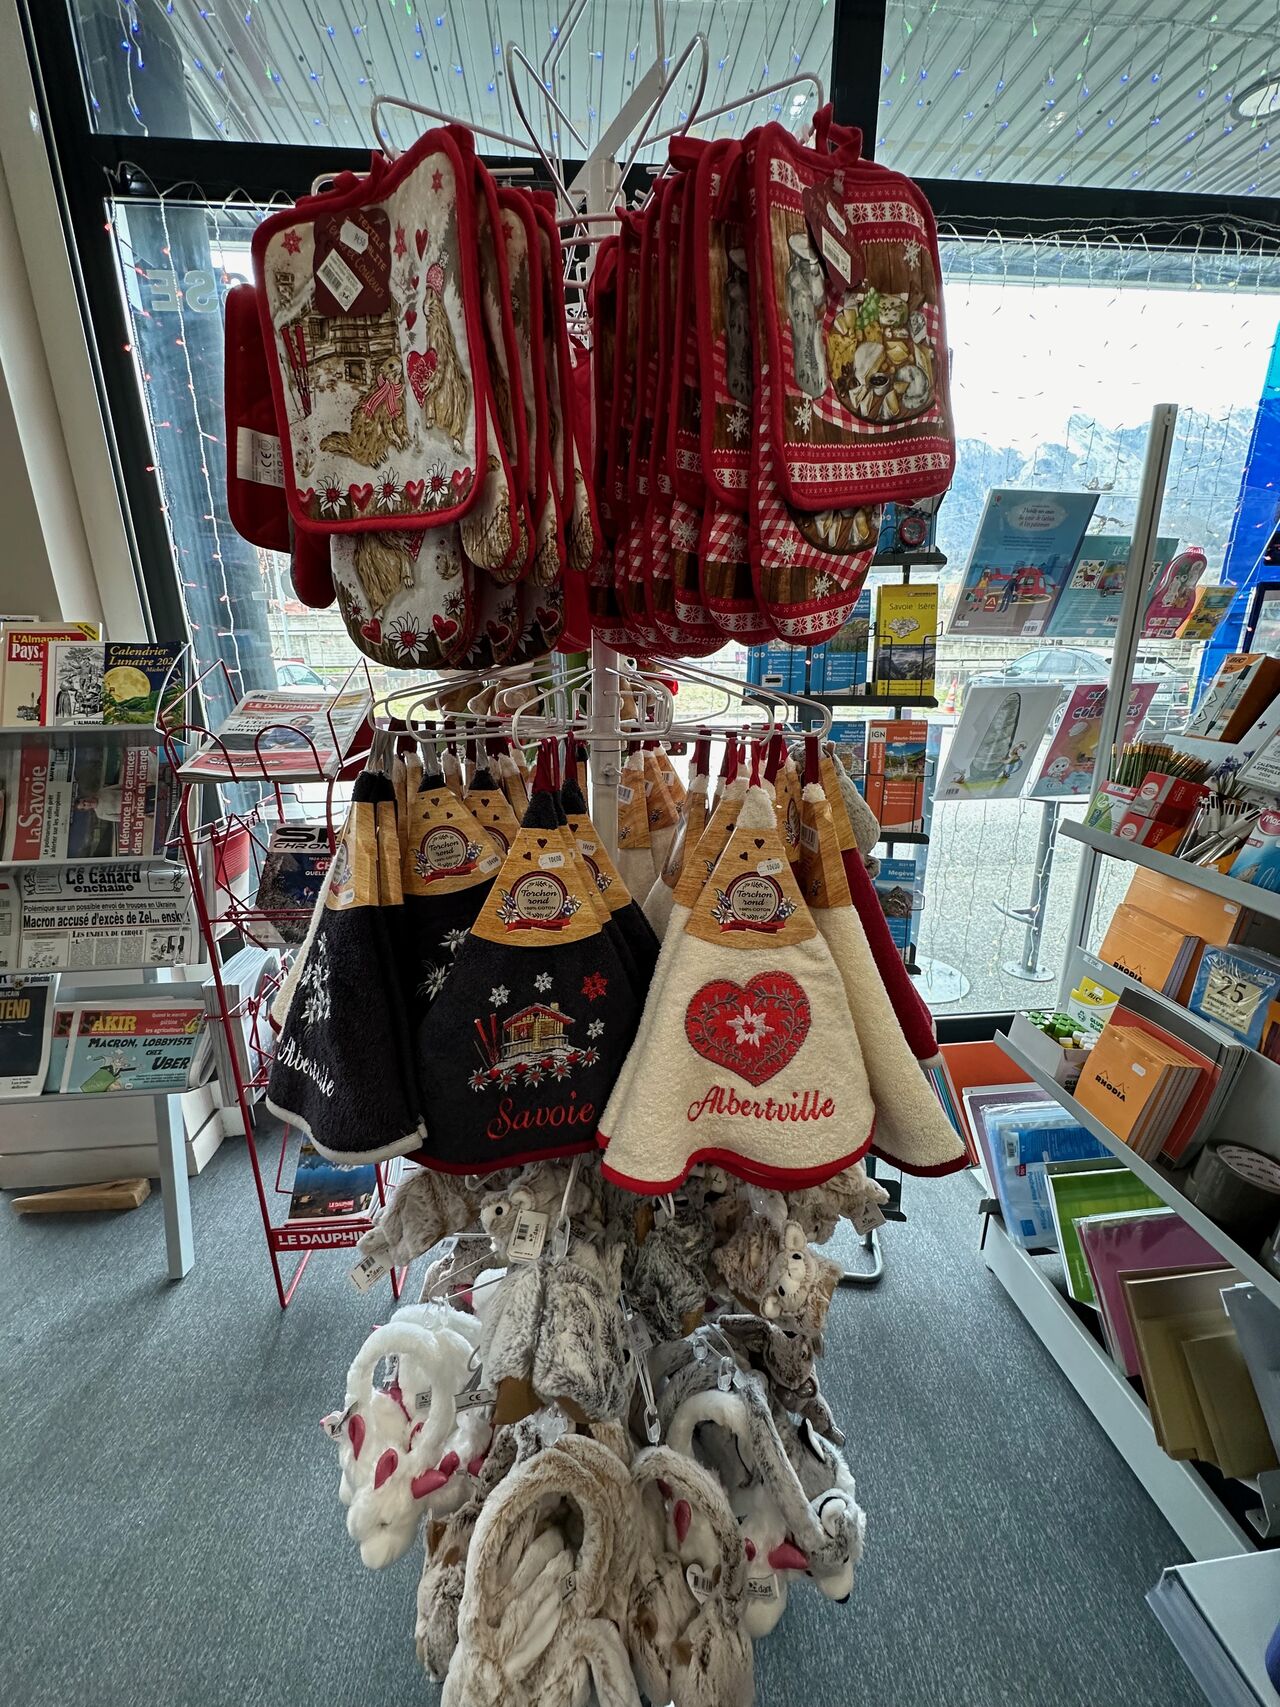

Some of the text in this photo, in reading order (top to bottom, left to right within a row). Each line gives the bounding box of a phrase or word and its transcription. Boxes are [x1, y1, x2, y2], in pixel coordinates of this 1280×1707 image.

[889, 602, 936, 611] Savoie Isère
[11, 643, 40, 661] Pays
[109, 645, 169, 657] Calendrier
[108, 657, 176, 667] Lunaire 202
[871, 731, 886, 739] IGN
[125, 750, 136, 790] carences
[123, 791, 133, 805] les
[132, 749, 150, 854] dans la prise en charge
[120, 806, 134, 846] dénonce
[428, 840, 460, 852] Torchon
[435, 847, 455, 856] rond
[66, 867, 142, 886] Le Canard
[888, 869, 915, 877] Megève
[520, 889, 558, 898] Torchon
[736, 890, 773, 898] Torchon
[23, 904, 56, 912] Polémique
[76, 902, 101, 911] possible
[101, 902, 118, 910] envoi
[117, 902, 126, 910] de
[125, 901, 147, 911] troupes
[155, 901, 177, 909] Ukraine
[527, 897, 550, 905] rond
[743, 898, 765, 906] rond
[23, 914, 56, 929] Macron
[57, 913, 89, 928] accusé
[91, 912, 125, 926] d'excès
[126, 912, 138, 925] de
[1216, 975, 1248, 1004] 25
[87, 1036, 195, 1049] MACRON, LOBBYISTE
[151, 1056, 191, 1071] UBER
[1094, 1073, 1126, 1102] RHODIA
[687, 1084, 836, 1123] Albertville
[487, 1089, 596, 1141] Savoie
[278, 1230, 367, 1246] LE DAUPHIN
